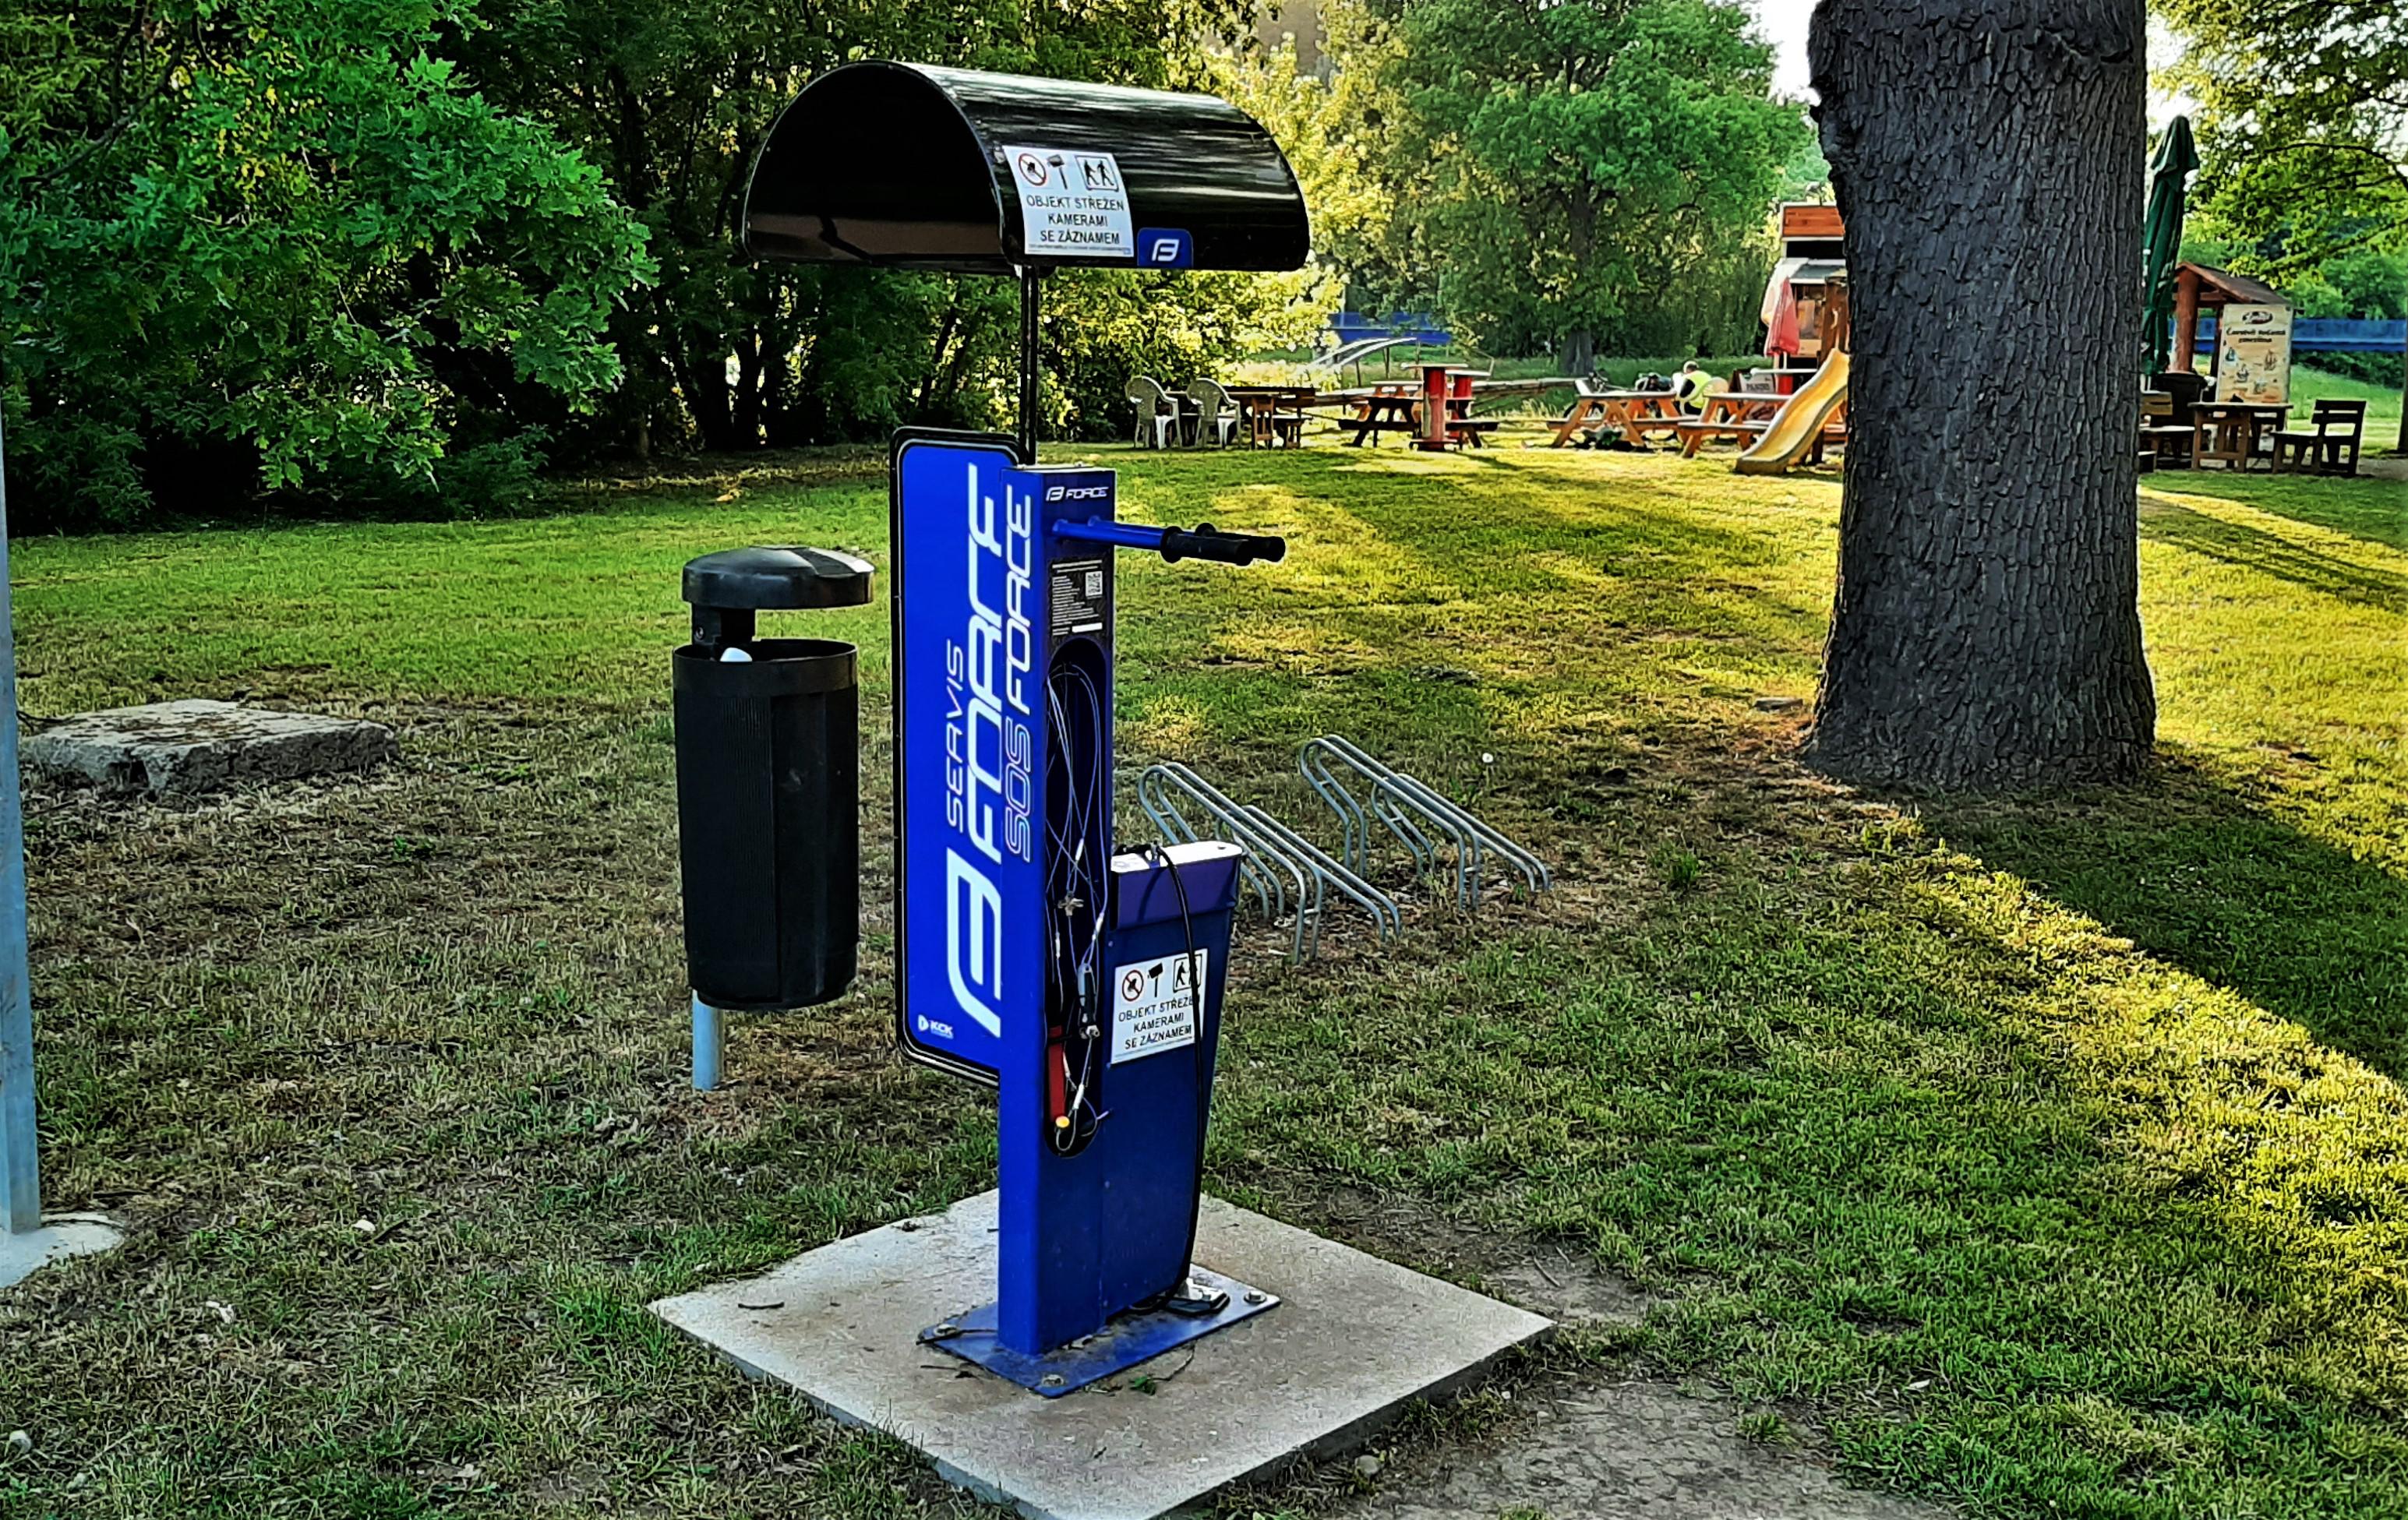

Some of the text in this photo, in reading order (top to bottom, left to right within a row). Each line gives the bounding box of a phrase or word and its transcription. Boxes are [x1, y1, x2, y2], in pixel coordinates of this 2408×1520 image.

[1026, 195, 1125, 211] OBJEKT STŘEŽEN
[1048, 213, 1108, 227] KAMERAMI
[1040, 229, 1120, 245] SE ZÁZNAMEM
[1065, 486, 1109, 499] FORCE
[1005, 483, 1031, 863] SOS FORCE
[946, 639, 963, 834] SERVIS
[1118, 995, 1199, 1022] OBJEKT STŘEŽE
[1134, 1012, 1185, 1033] KAMERAMI
[1125, 1038, 1138, 1049] SE
[1140, 1024, 1192, 1046] ZÁZNAMEM
